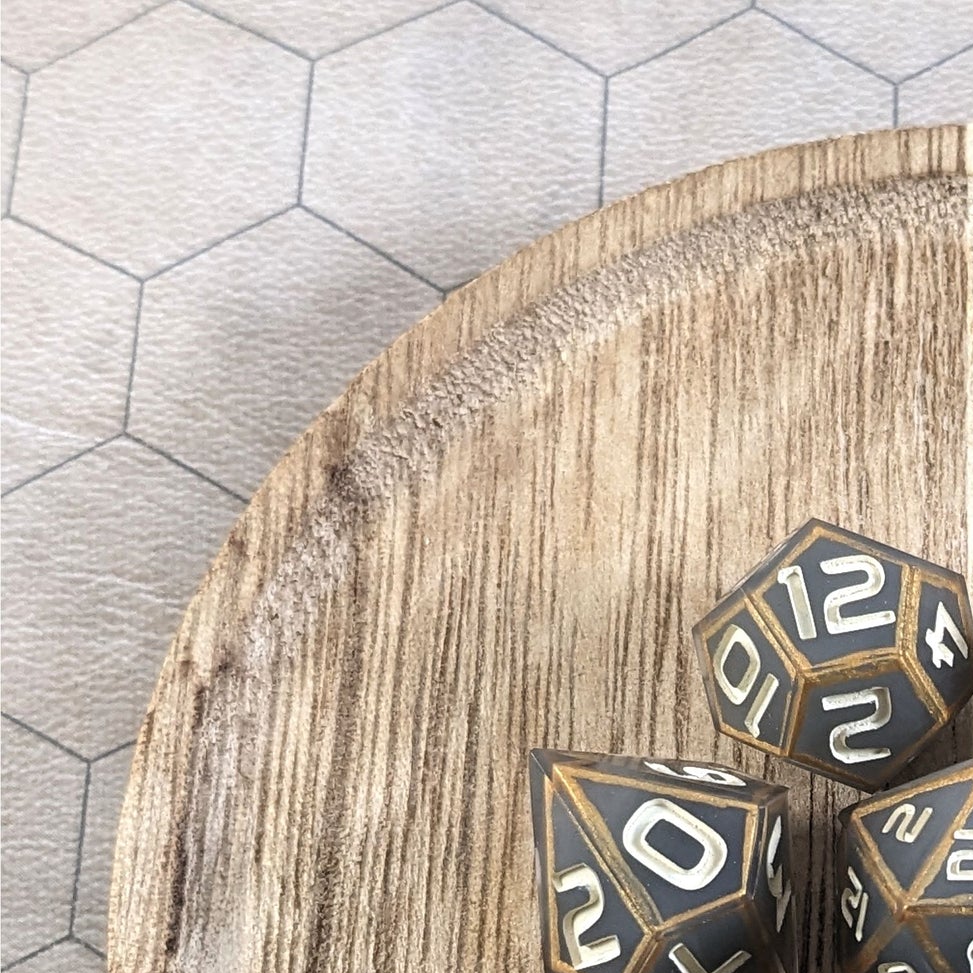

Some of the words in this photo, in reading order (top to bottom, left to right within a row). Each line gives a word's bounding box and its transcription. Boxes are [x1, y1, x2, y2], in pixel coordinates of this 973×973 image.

[777, 554, 896, 639] 12
[925, 601, 968, 668] 4
[713, 624, 779, 738] 10
[622, 797, 728, 891] 0
[882, 803, 933, 844] 2
[551, 862, 622, 970] 2
